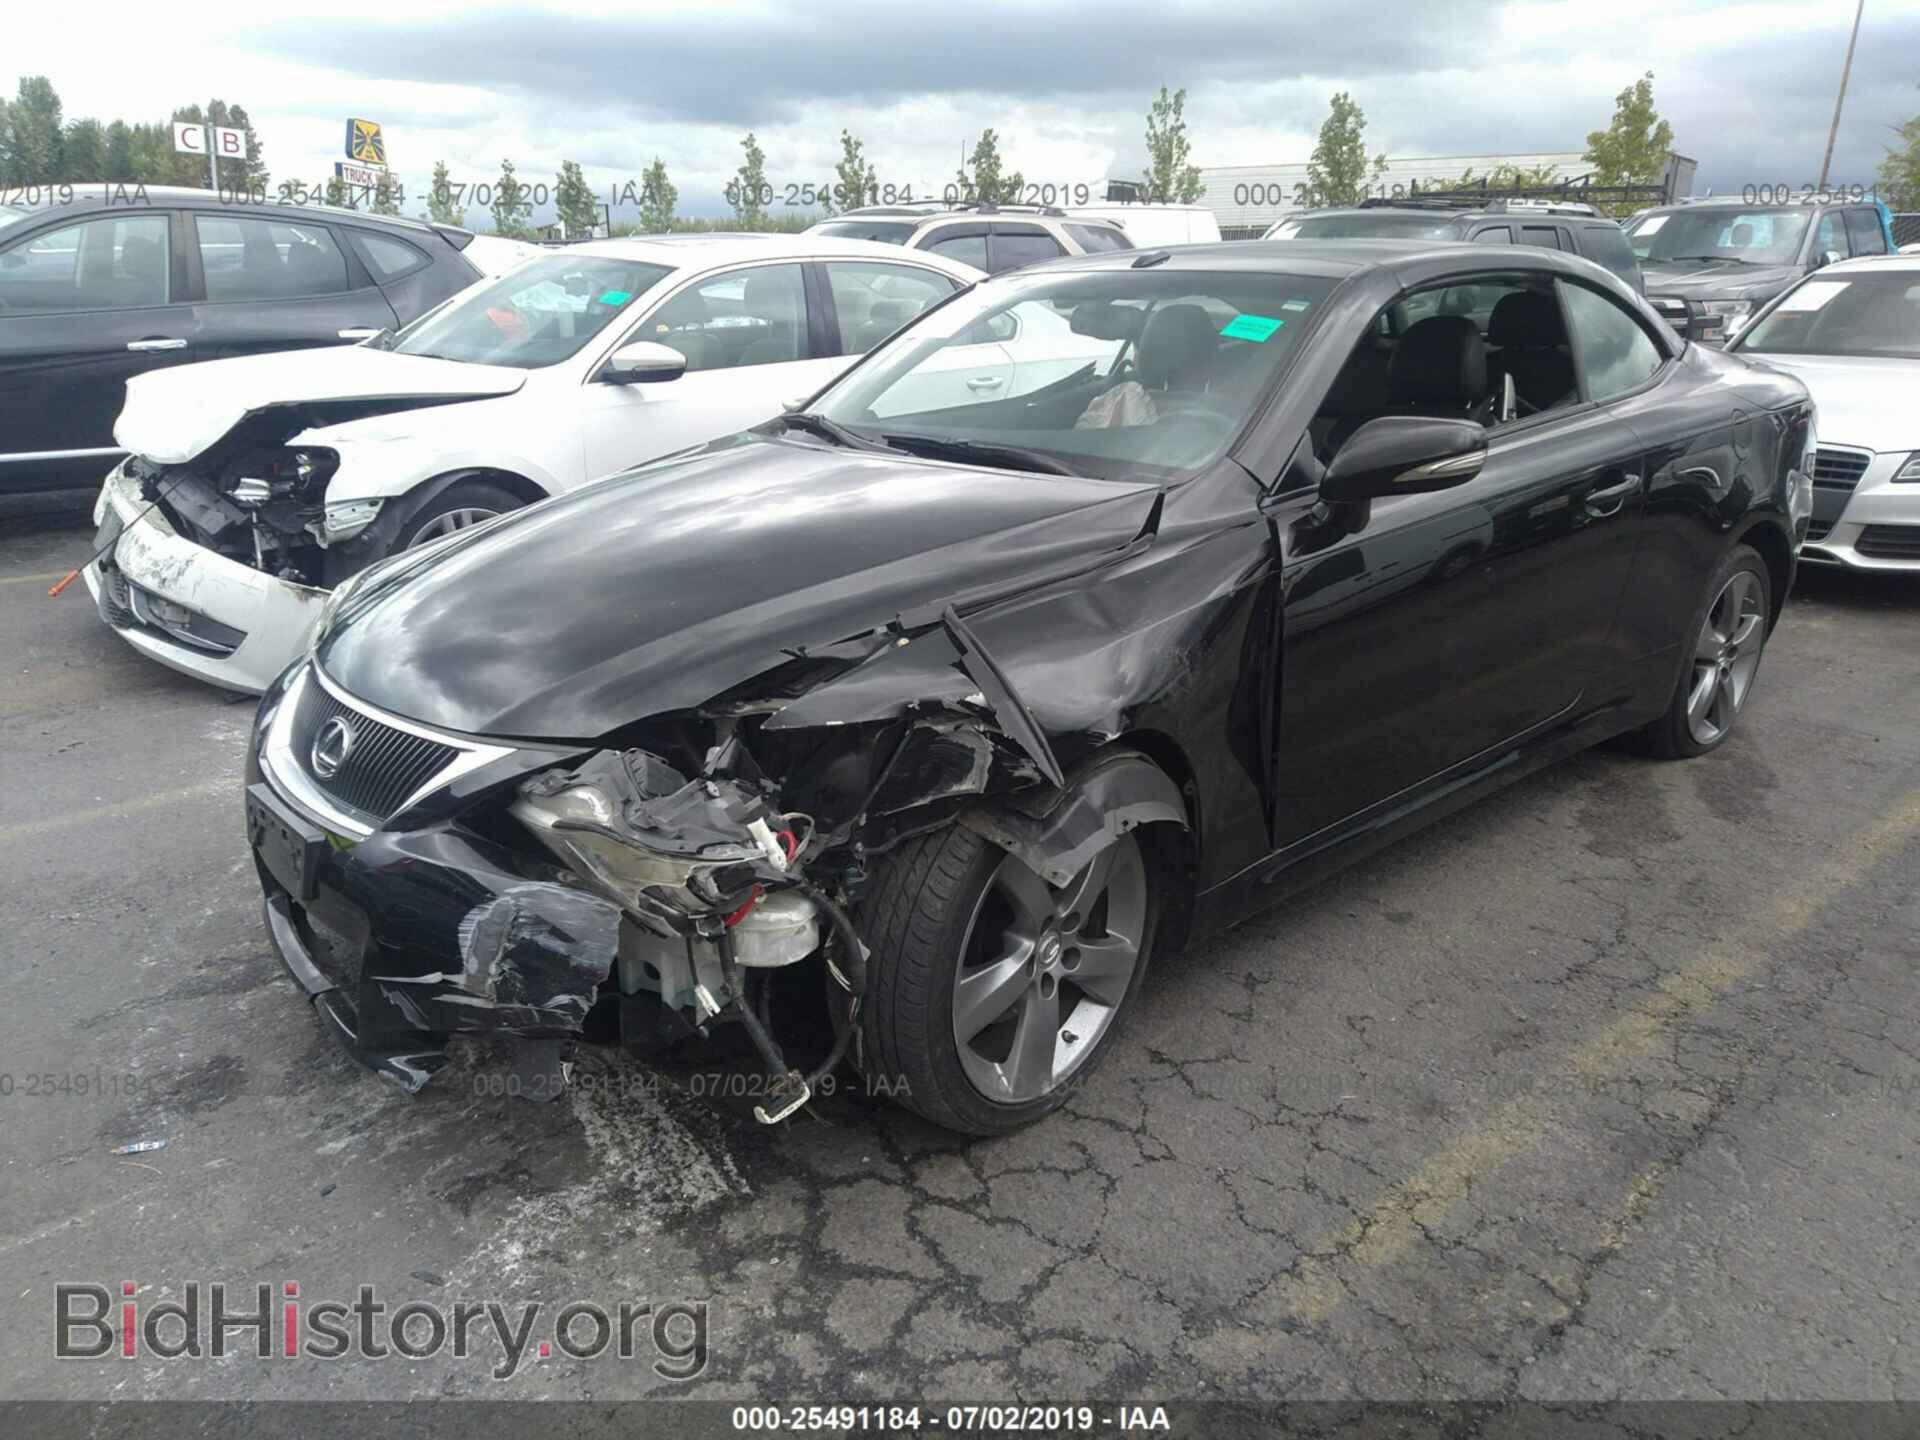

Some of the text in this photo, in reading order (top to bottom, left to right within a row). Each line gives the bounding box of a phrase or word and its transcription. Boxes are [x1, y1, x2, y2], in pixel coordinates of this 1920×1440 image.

[181, 127, 200, 150] C
[223, 132, 240, 153] B
[344, 166, 373, 185] TRUCK
